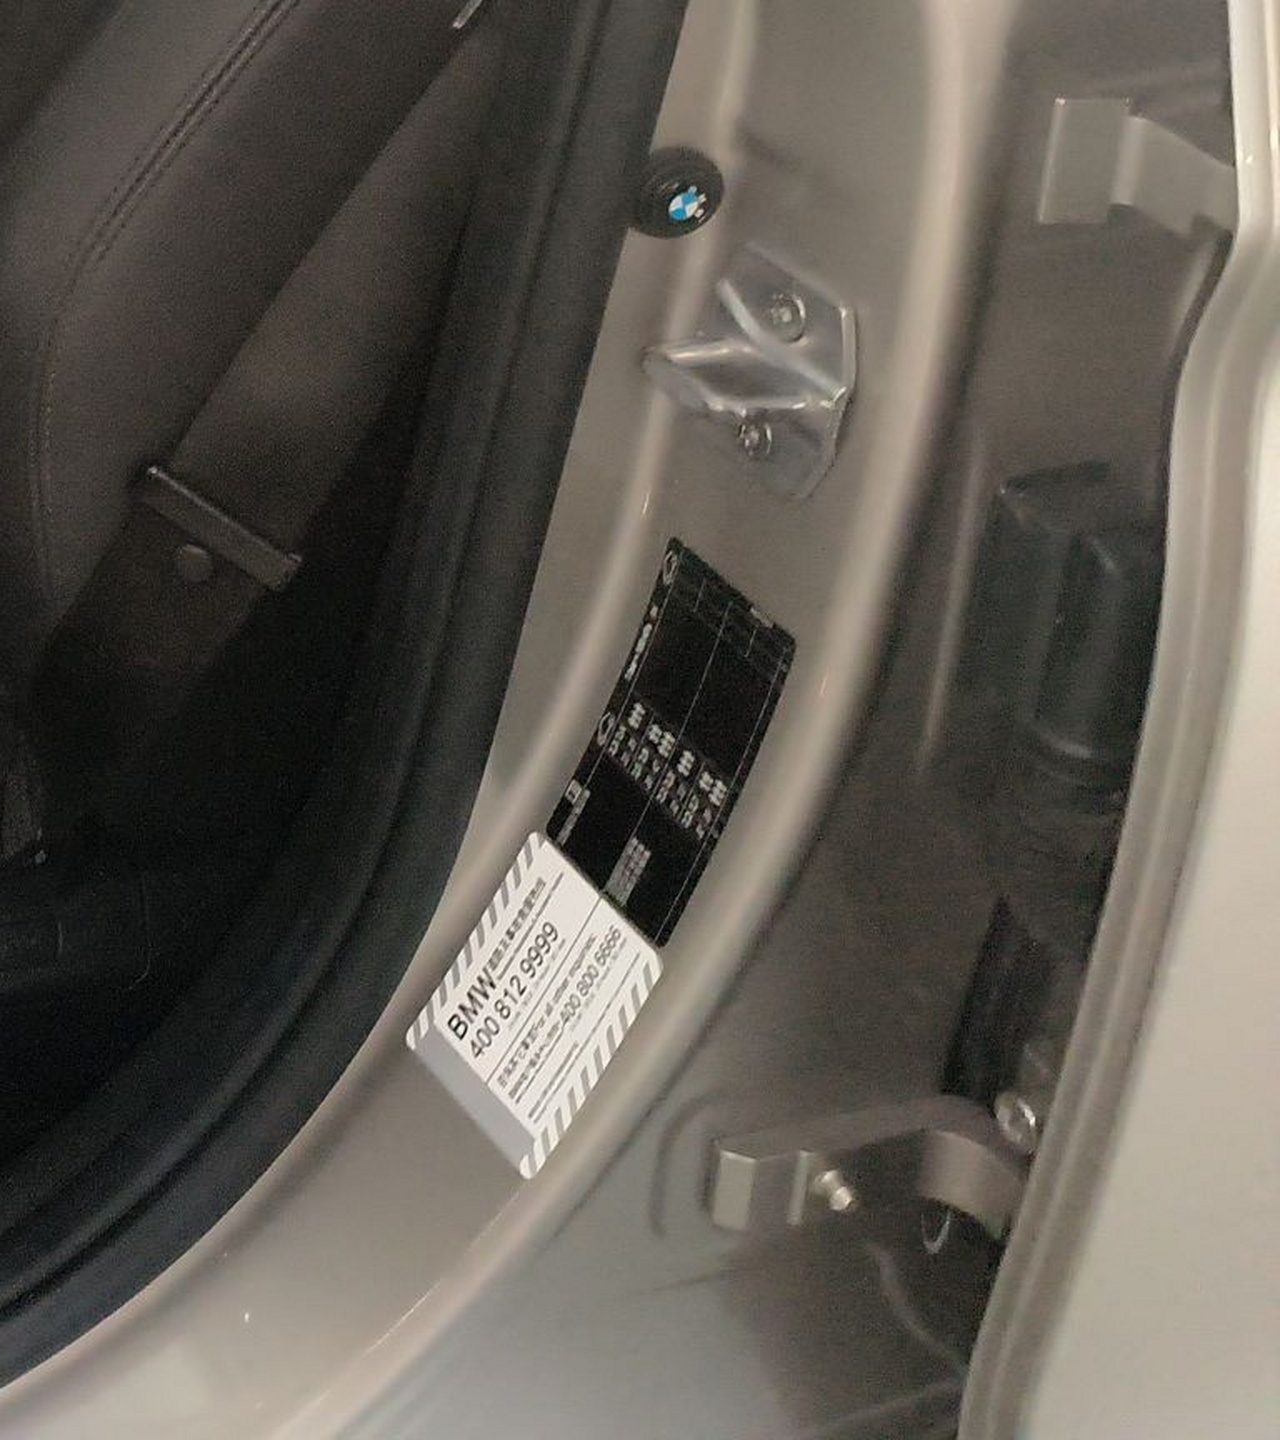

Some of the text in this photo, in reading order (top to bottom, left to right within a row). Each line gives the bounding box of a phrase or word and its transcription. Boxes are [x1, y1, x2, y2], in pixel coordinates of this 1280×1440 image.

[447, 966, 496, 1040] BMW
[470, 1016, 500, 1059] 400
[494, 974, 527, 1020] 812
[520, 921, 558, 979] 9999
